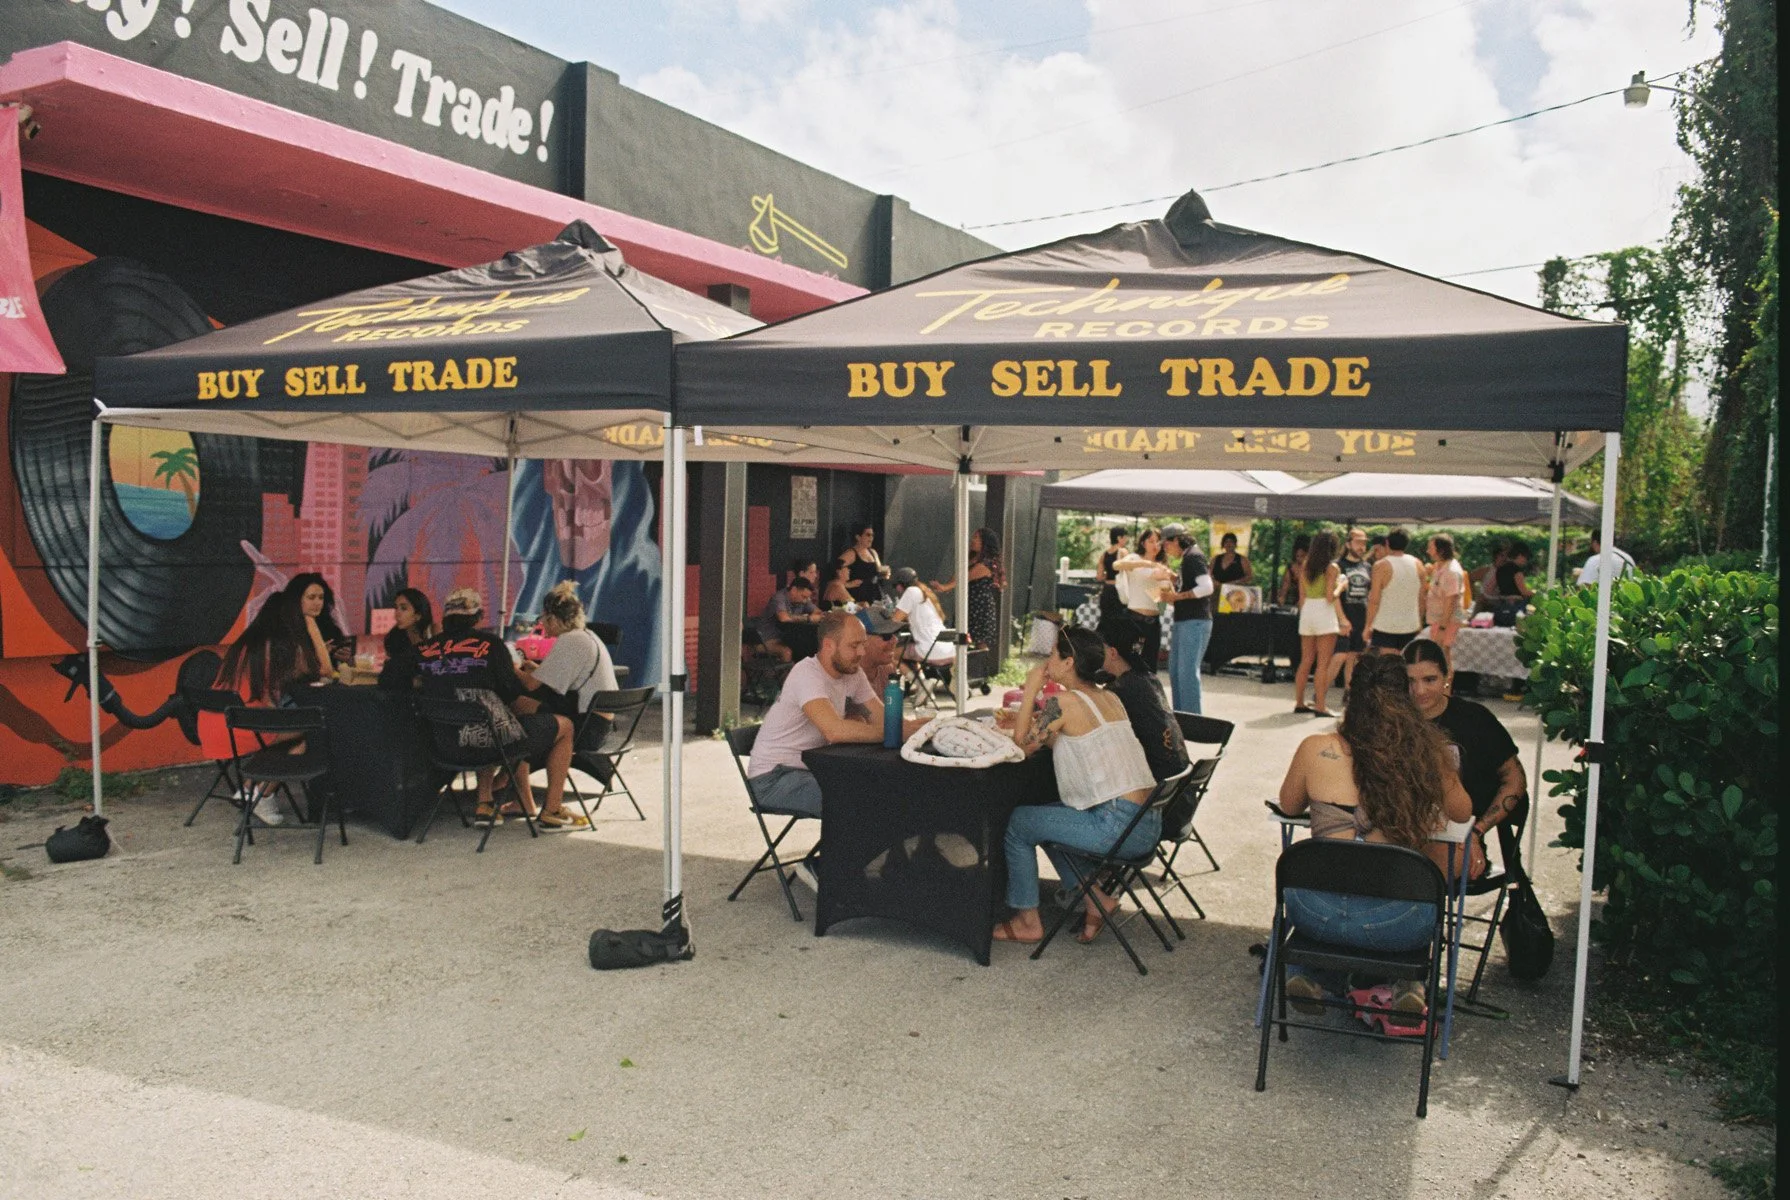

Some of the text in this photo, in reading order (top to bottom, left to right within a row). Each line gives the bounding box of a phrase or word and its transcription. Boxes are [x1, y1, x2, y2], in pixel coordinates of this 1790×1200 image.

[220, 0, 378, 99] Sell!
[391, 49, 554, 162] Trade!
[915, 273, 1352, 335] Technique
[332, 318, 531, 344] RECORDS
[1033, 314, 1331, 339] RECORDS
[197, 355, 519, 400] BUY SELL TRADE
[847, 356, 1371, 398] BUY SELL TRADE
